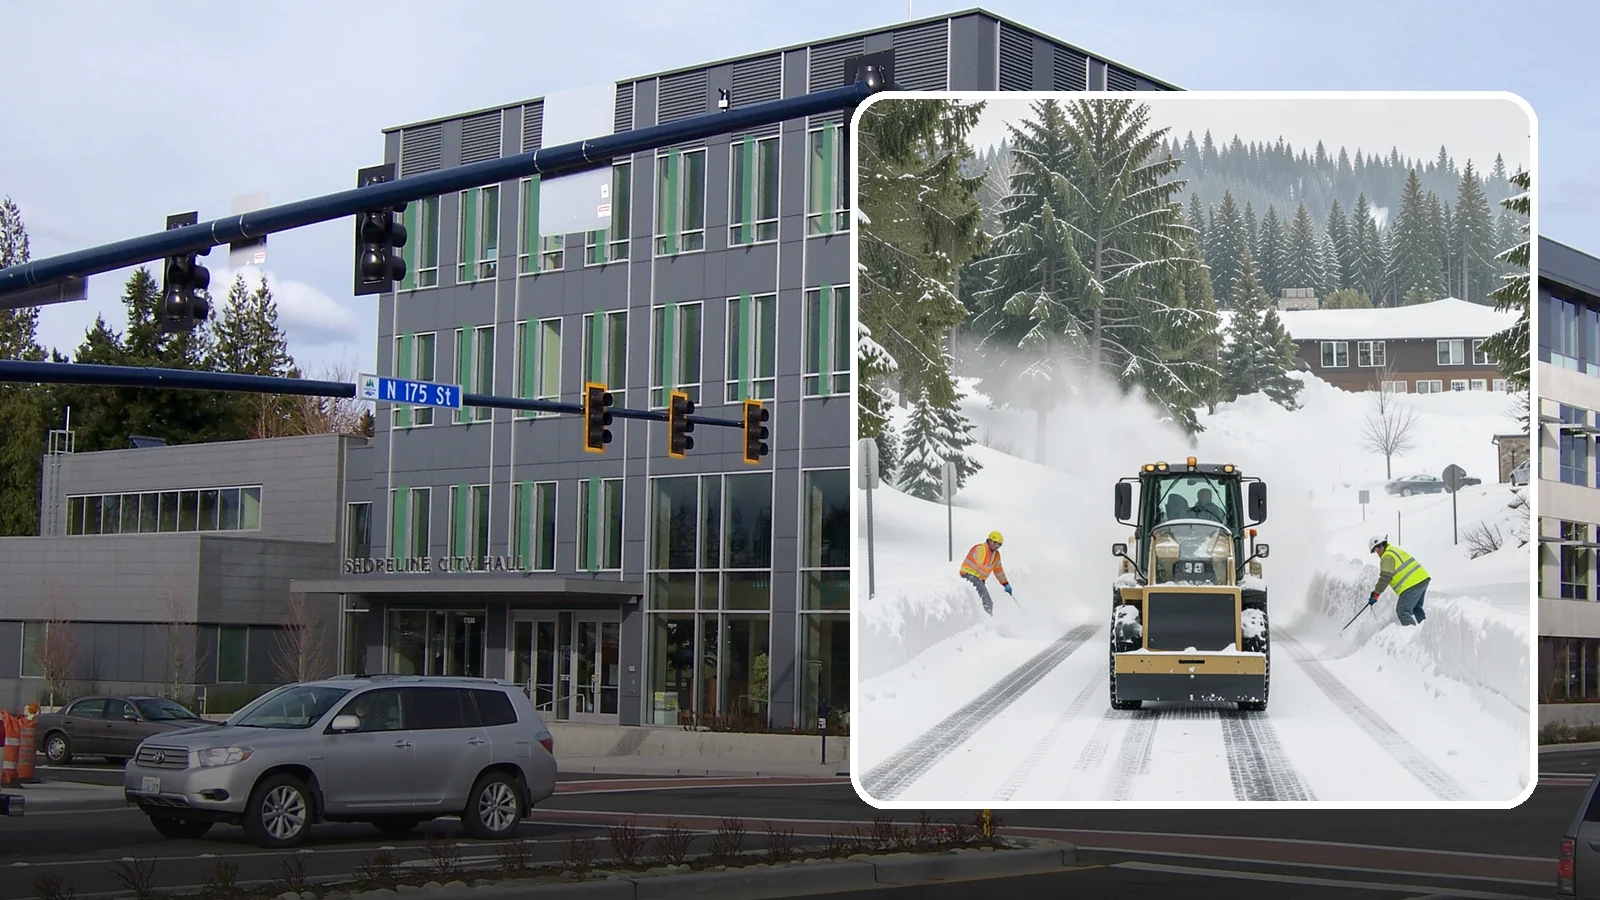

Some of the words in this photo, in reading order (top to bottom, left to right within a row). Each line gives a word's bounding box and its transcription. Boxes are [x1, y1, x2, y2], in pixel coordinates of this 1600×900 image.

[387, 380, 397, 400] N
[405, 382, 427, 403] 175
[436, 386, 451, 406] St
[345, 557, 432, 574] SHORELINE
[438, 556, 476, 572] CITY
[484, 555, 526, 571] HALL
